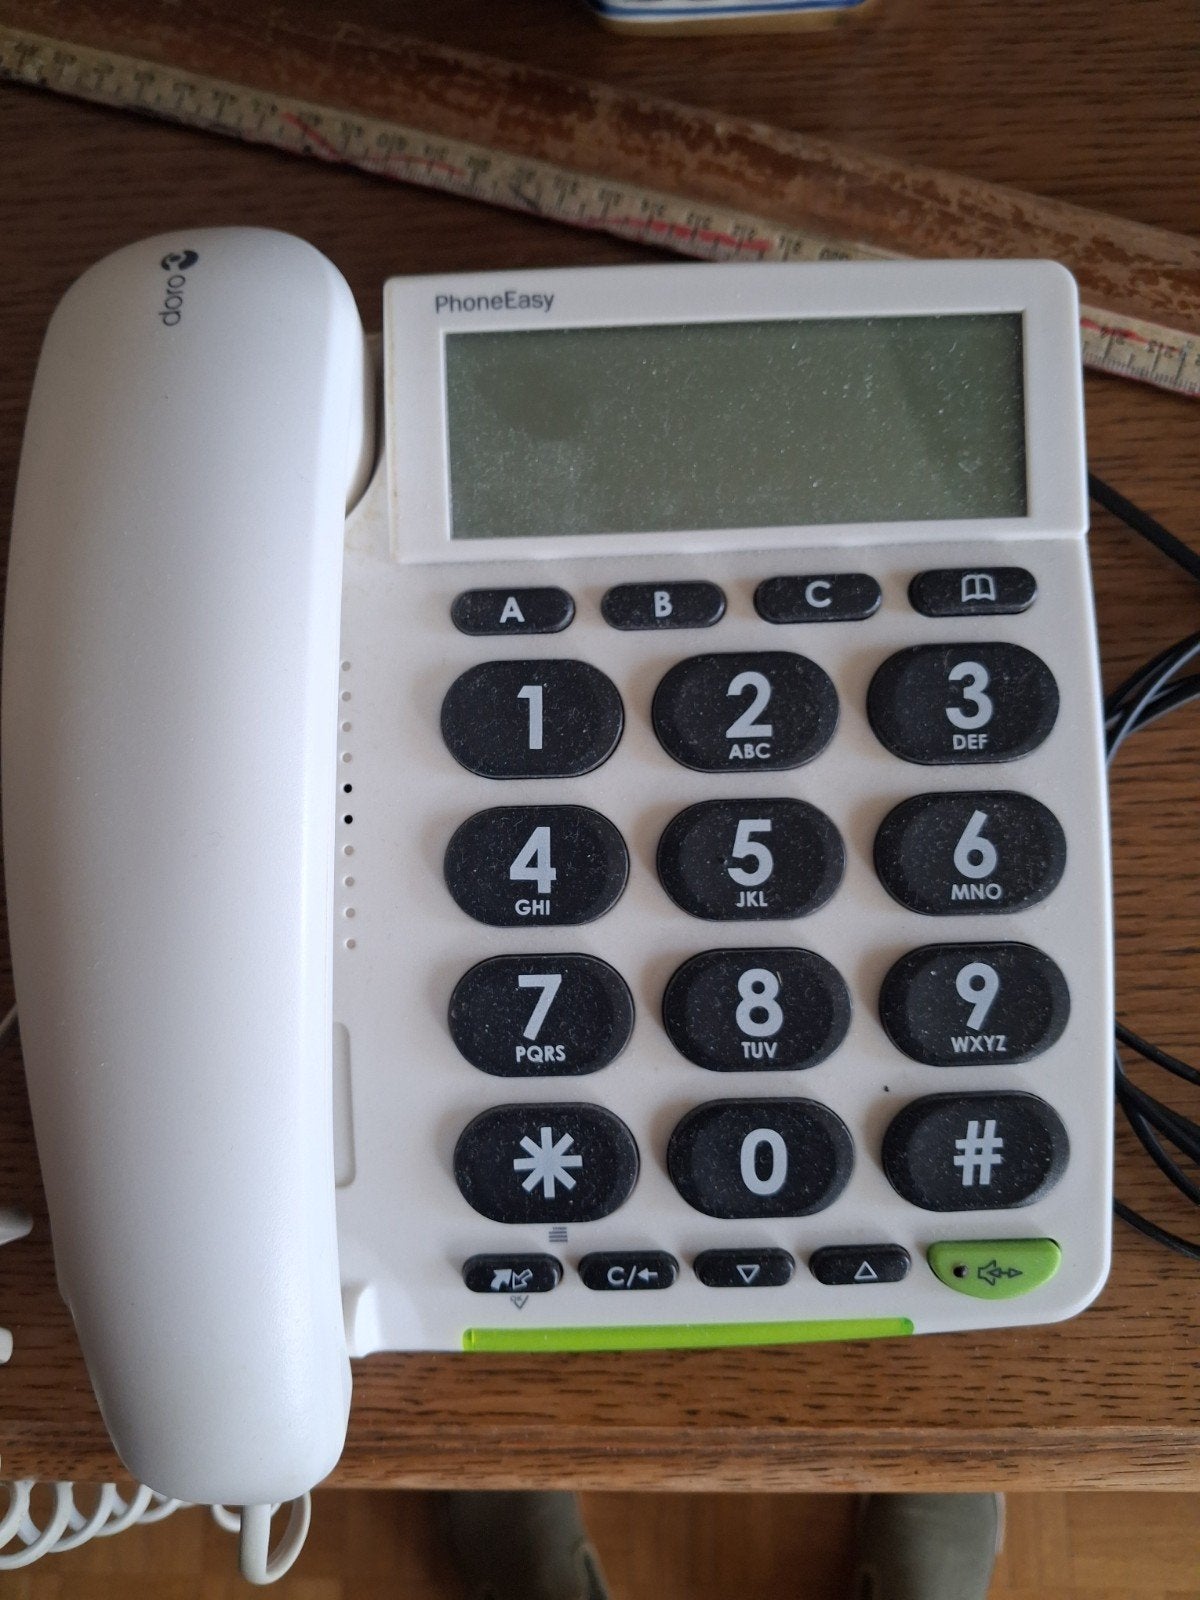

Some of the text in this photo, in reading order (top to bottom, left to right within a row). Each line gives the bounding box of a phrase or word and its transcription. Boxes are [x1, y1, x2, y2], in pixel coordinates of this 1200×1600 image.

[159, 274, 186, 327] doro
[434, 290, 555, 314] PhoneEasy
[653, 590, 673, 619] B
[804, 579, 833, 609] C
[499, 596, 526, 624] A
[725, 670, 773, 740] 2
[945, 661, 994, 730] 3
[516, 685, 544, 751] 1
[728, 742, 772, 760] ABC
[952, 734, 989, 751] DEF
[727, 818, 774, 887] 5
[953, 809, 998, 880] 6
[509, 825, 557, 895] 4
[736, 891, 769, 909] JKL
[951, 883, 1002, 901] MNO
[514, 899, 551, 917] GHI
[517, 973, 563, 1042] 7
[735, 967, 784, 1038] 8
[956, 962, 999, 1032] 9
[515, 1045, 567, 1064] PQRS
[741, 1041, 779, 1060] TUV
[950, 1035, 1007, 1053] WXYZ
[739, 1127, 788, 1197] 0
